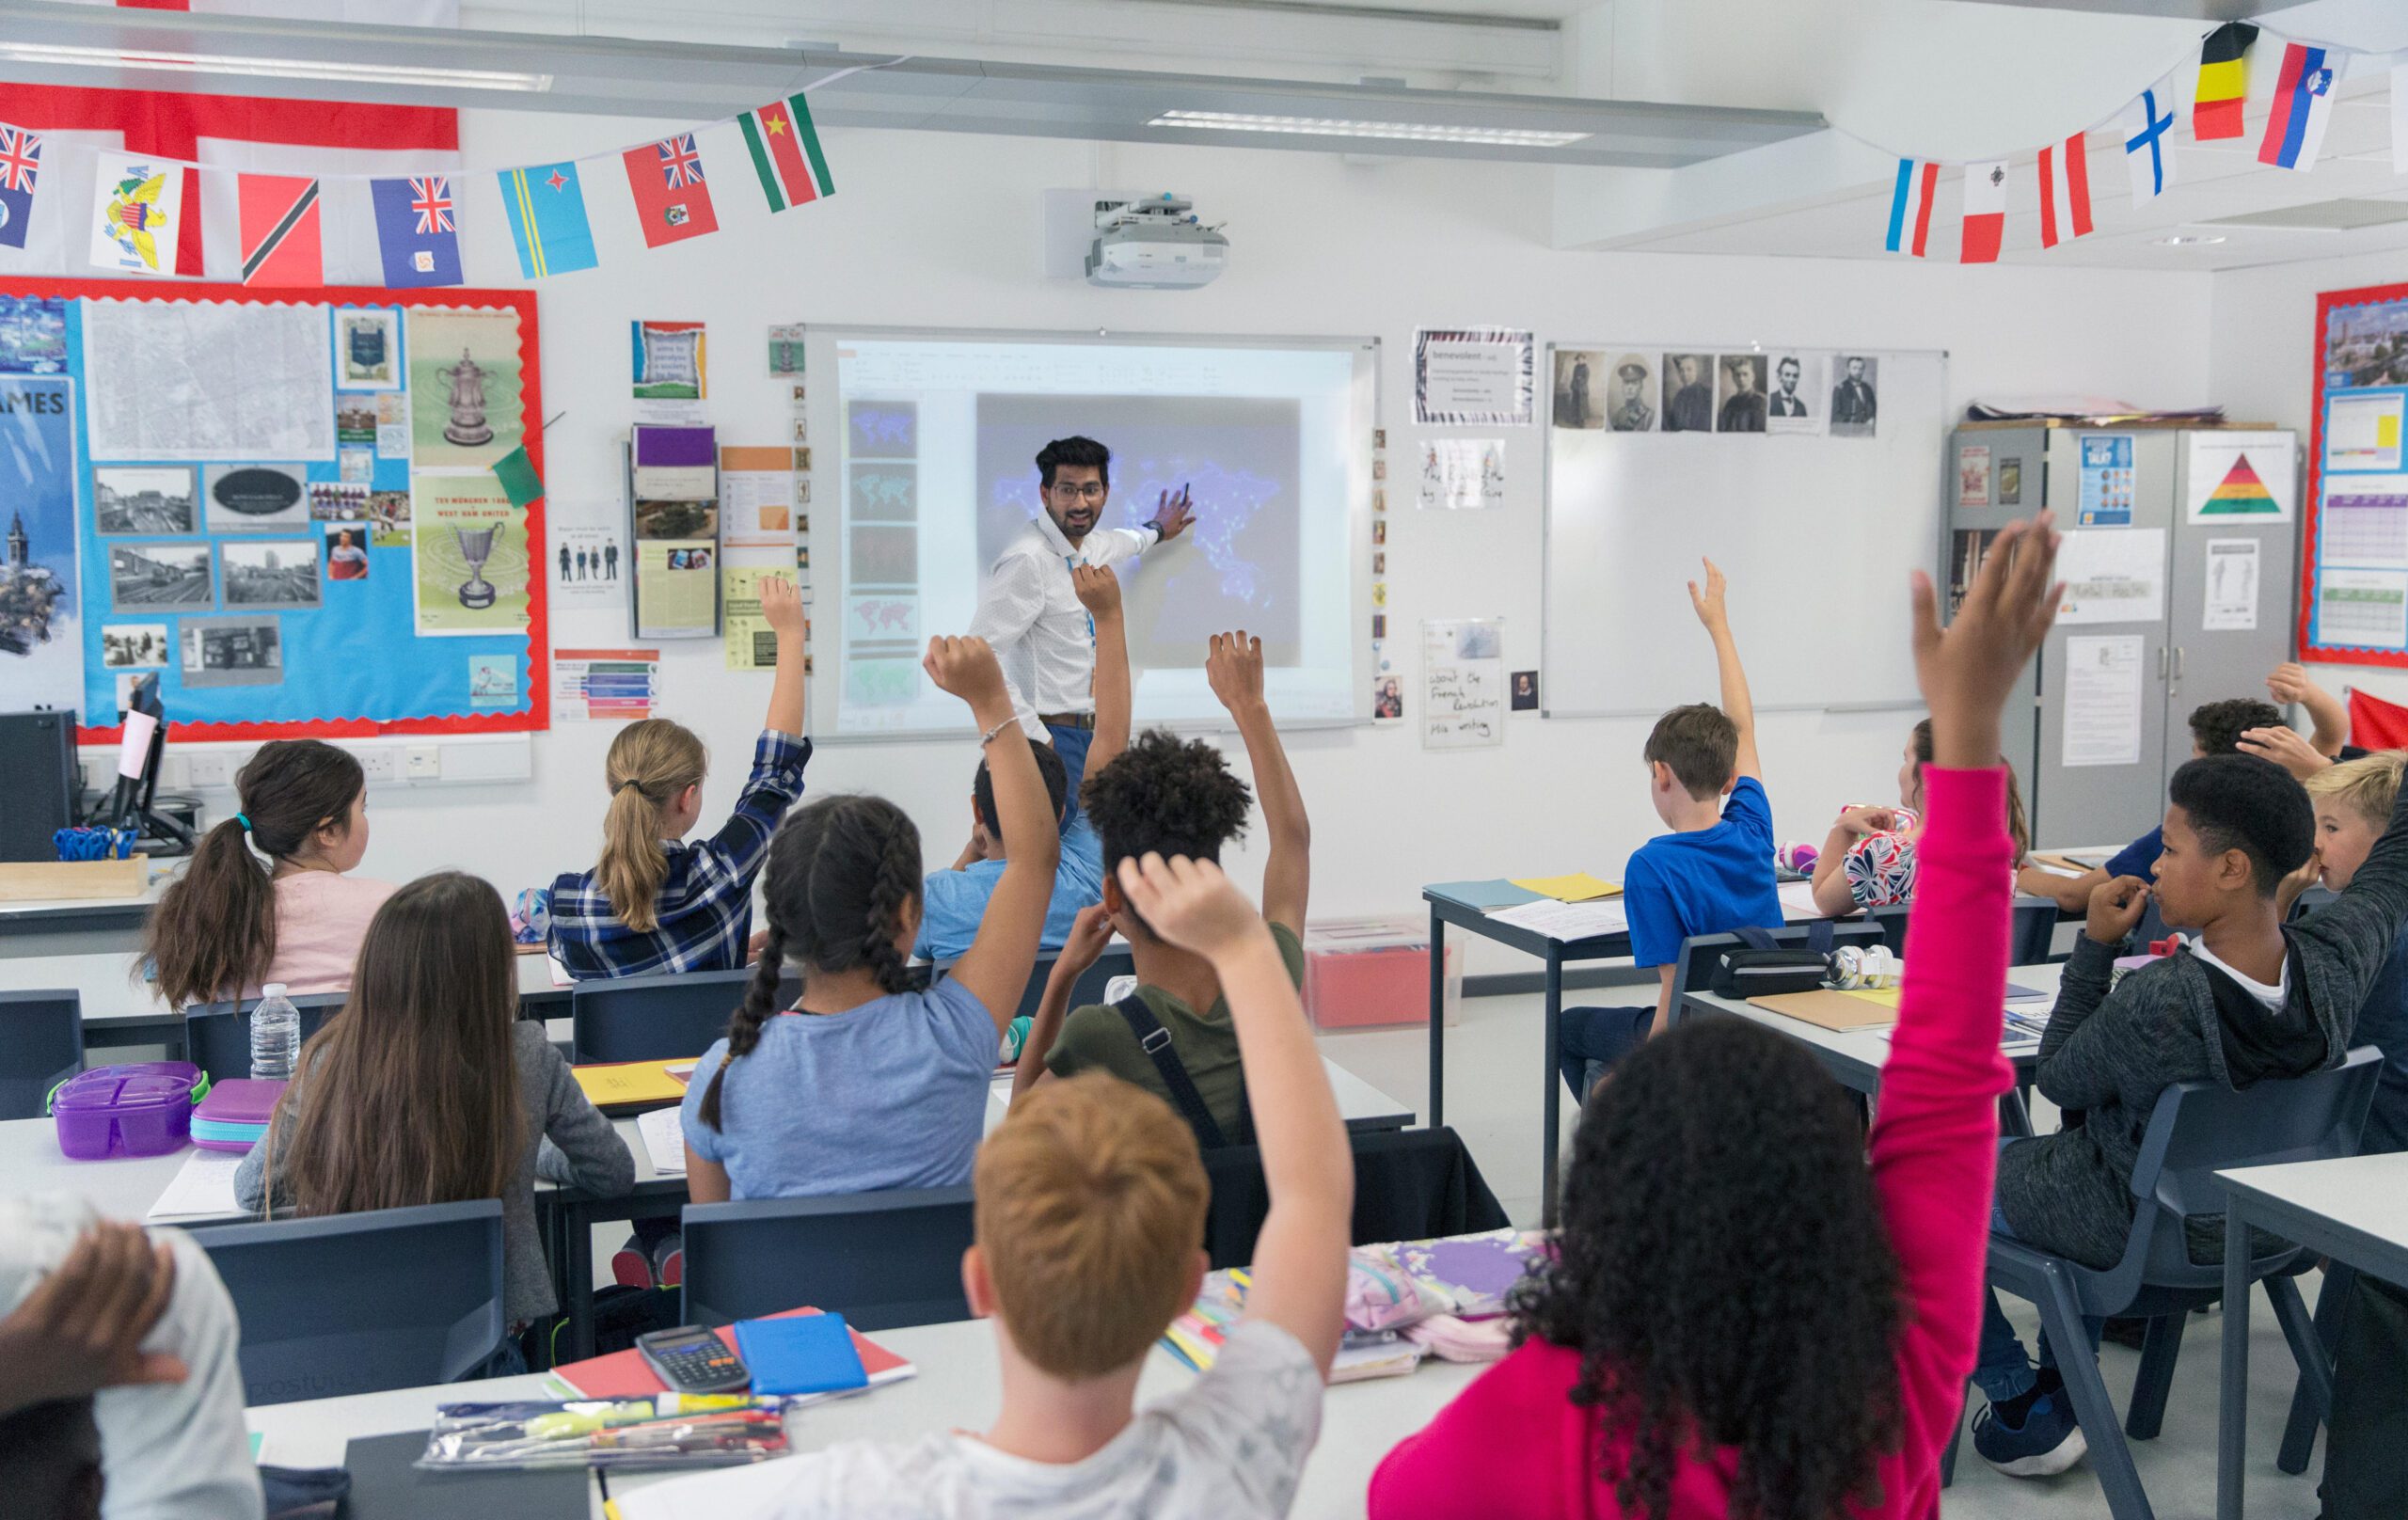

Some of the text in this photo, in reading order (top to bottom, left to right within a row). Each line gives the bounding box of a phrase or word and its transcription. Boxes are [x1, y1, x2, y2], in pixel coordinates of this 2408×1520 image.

[1432, 350, 1481, 360] benevolent
[0, 391, 64, 414] MES
[1429, 671, 1458, 685] about
[1431, 686, 1465, 700] French
[1458, 718, 1491, 737] writing
